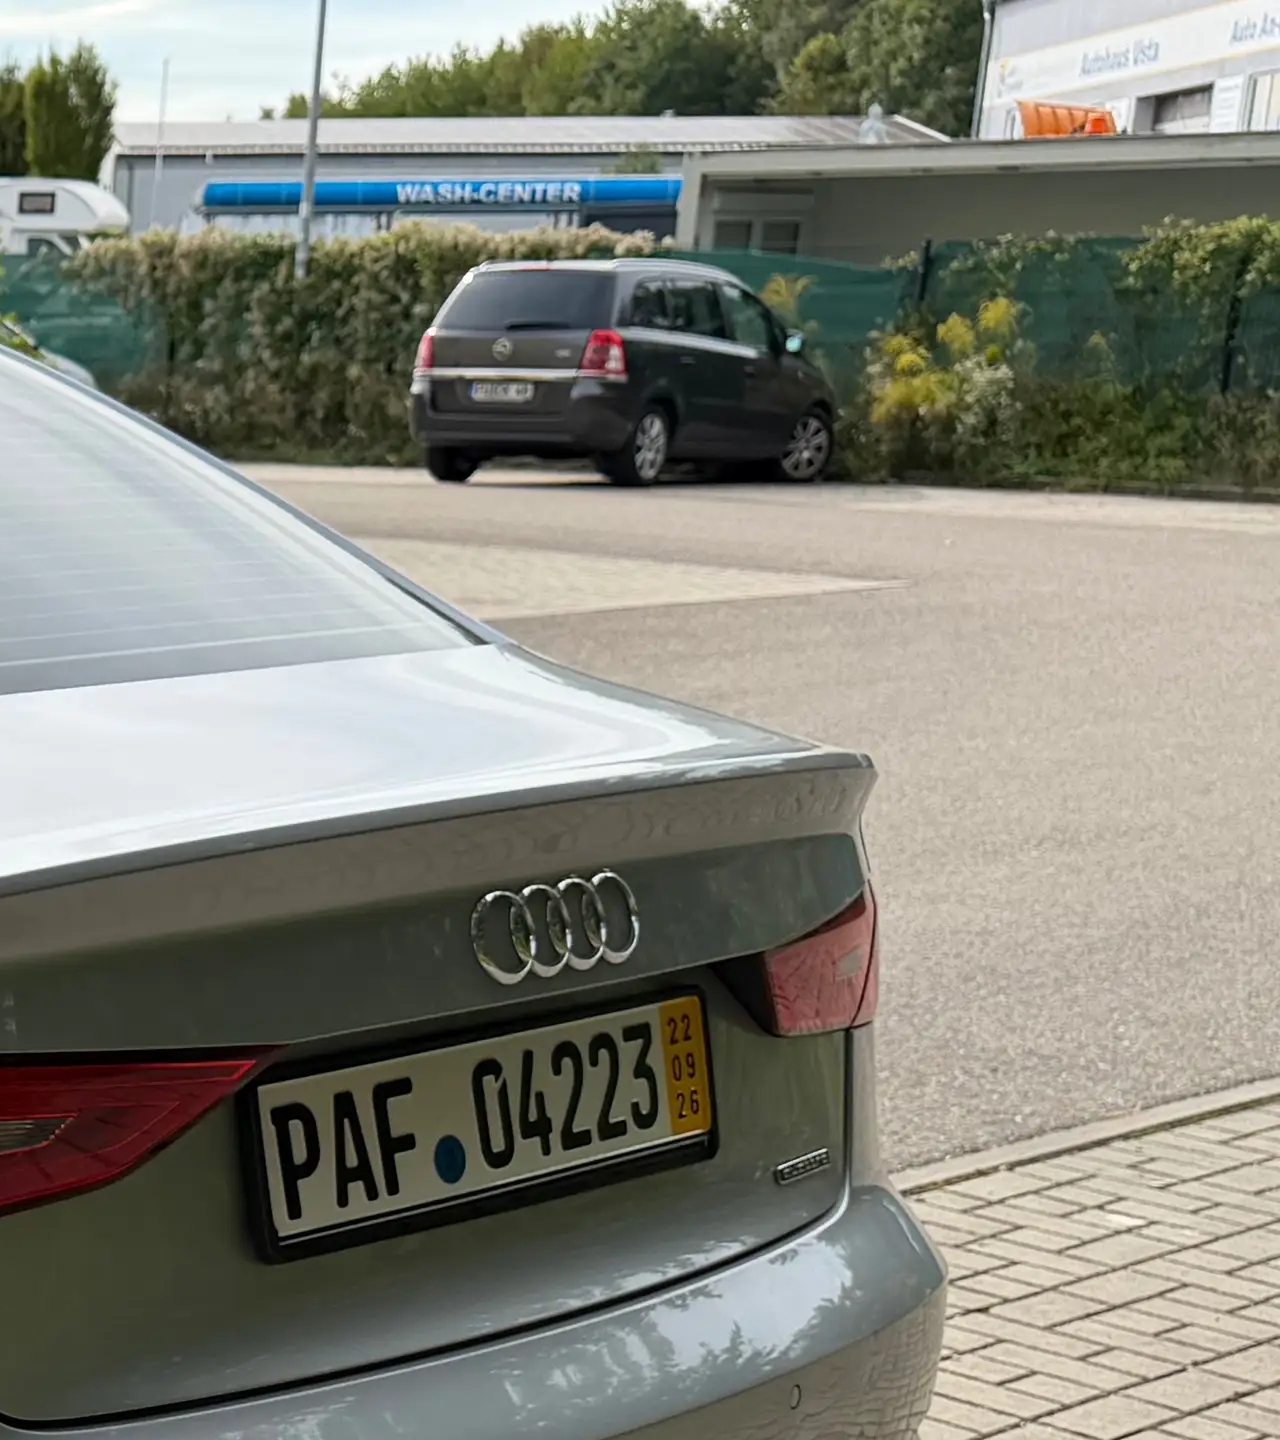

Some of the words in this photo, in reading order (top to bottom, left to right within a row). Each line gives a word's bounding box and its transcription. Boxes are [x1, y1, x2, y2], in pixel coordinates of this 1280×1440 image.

[397, 183, 581, 204] WASH-CENTER
[667, 1013, 692, 1046] 22
[671, 1052, 696, 1082] 09
[676, 1088, 699, 1119] 26
[270, 1077, 416, 1221] PAF
[471, 1021, 659, 1170] 04223
